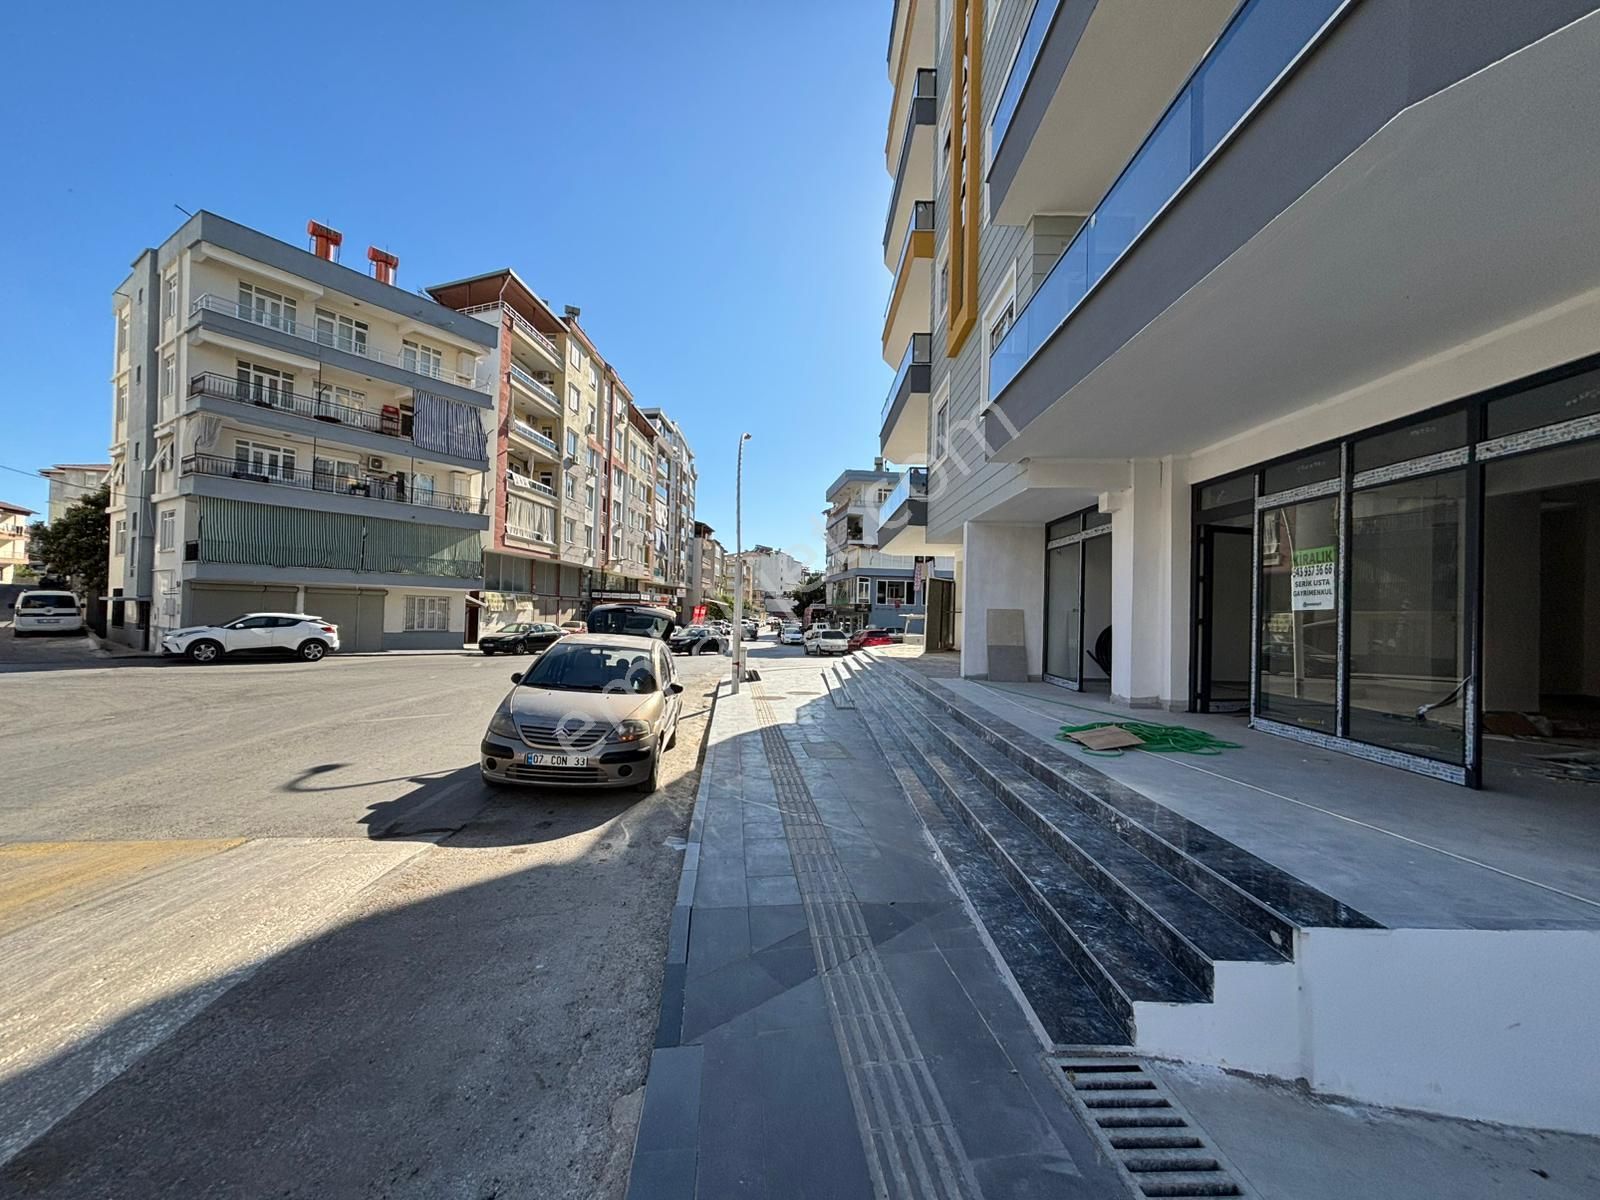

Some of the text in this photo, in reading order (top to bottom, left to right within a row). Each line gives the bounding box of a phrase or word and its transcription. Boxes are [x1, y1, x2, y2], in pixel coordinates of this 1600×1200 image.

[1293, 550, 1333, 567] KİRALIK
[1295, 578, 1330, 588] SERİK USTA
[1293, 589, 1333, 597] GAYRİMENKUL
[533, 754, 585, 767] 07 CON 33
